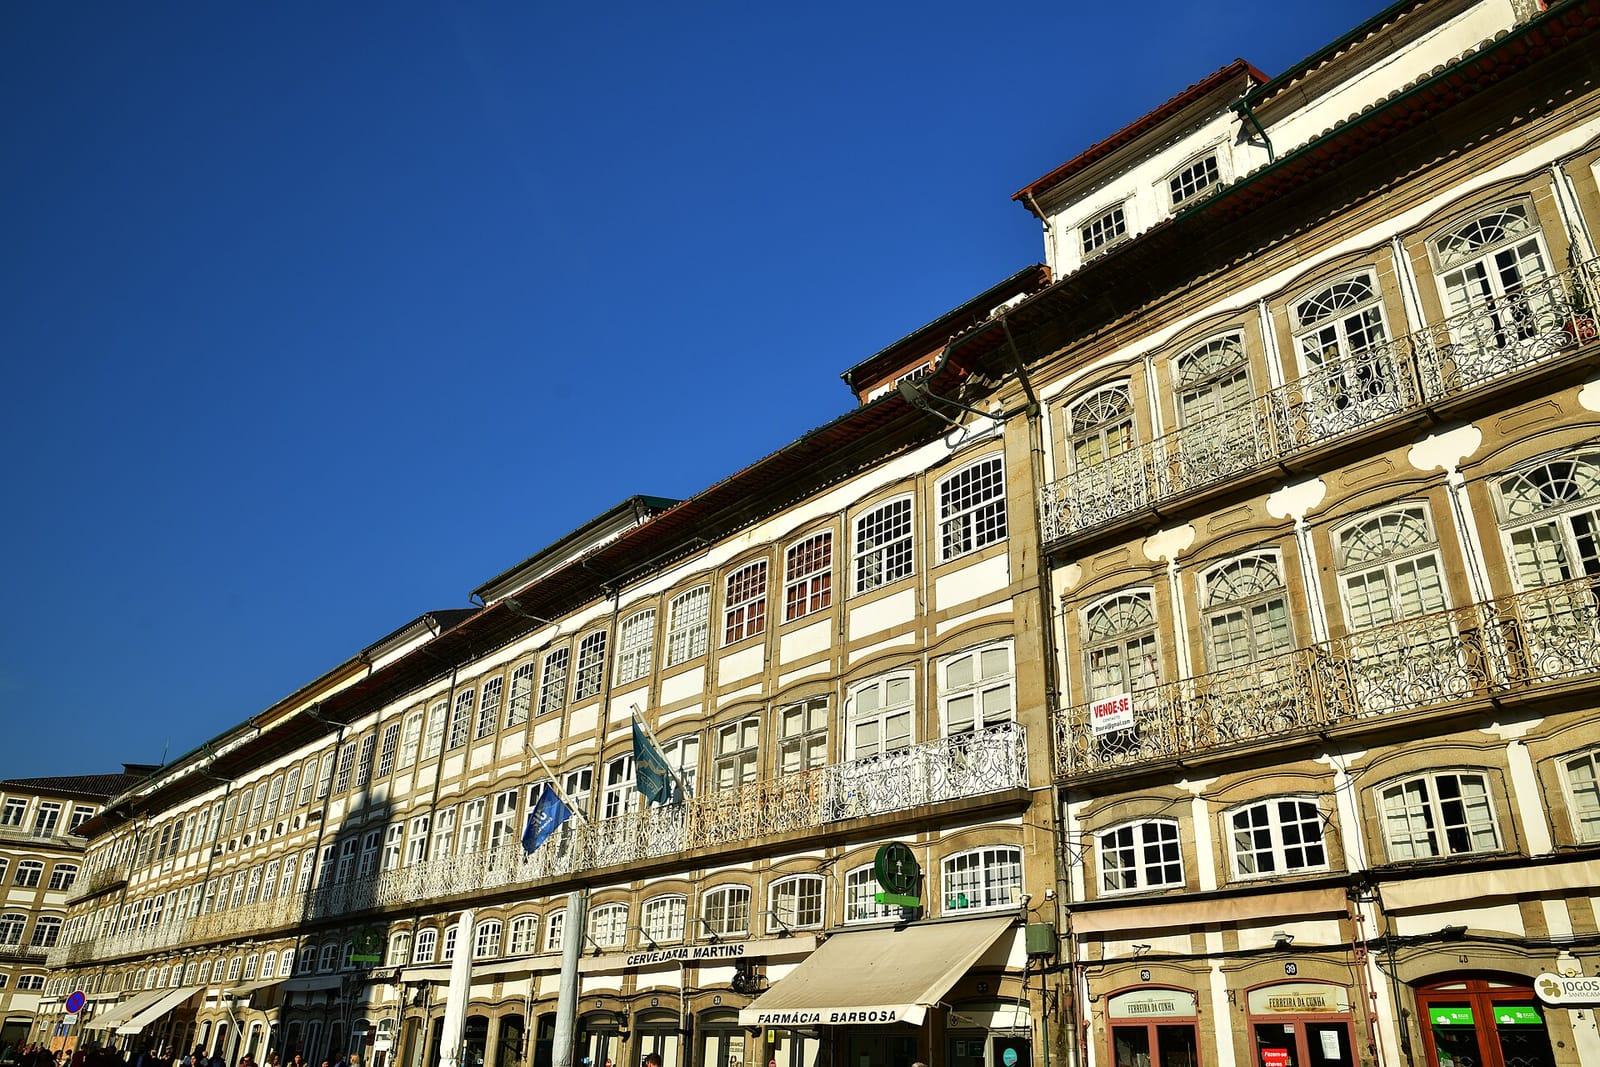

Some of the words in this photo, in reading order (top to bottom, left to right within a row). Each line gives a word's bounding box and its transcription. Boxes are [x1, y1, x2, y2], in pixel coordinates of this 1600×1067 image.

[1094, 698, 1129, 718] VENDE-SE
[627, 949, 688, 965] CERVEJARIA
[693, 945, 744, 958] MARTINS
[1285, 964, 1296, 974] 39
[1562, 981, 1600, 995] JOGOS
[1151, 1003, 1158, 1012] DA
[1158, 1002, 1175, 1012] CUNHA
[1269, 997, 1296, 1008] FERREIRA
[1297, 997, 1305, 1007] DA
[1306, 996, 1326, 1007] CUNHA
[758, 1012, 820, 1023] FARMÁCIA
[830, 1010, 896, 1023] BARBOSA
